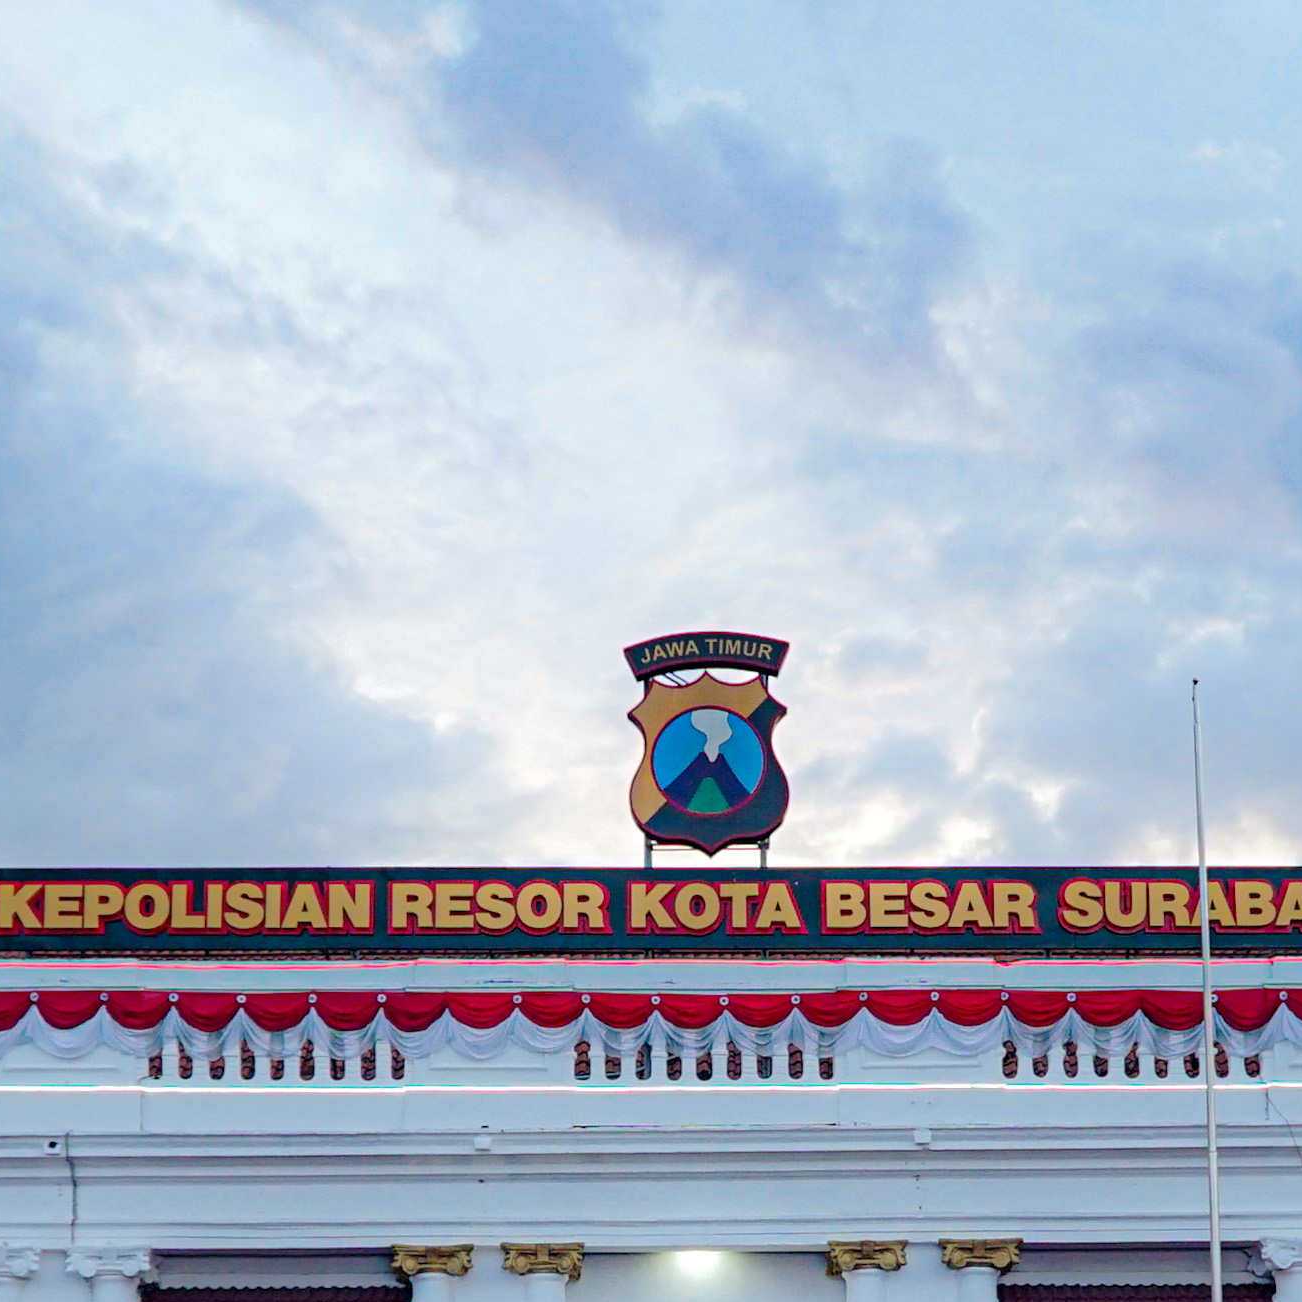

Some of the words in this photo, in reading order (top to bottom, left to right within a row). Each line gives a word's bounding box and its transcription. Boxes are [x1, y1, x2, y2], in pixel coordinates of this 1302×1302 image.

[641, 640, 700, 664] JAWA
[705, 639, 773, 660] TIMUR
[390, 880, 606, 932] RESOR
[629, 880, 803, 932] KOTA
[825, 880, 1037, 931] BESAR
